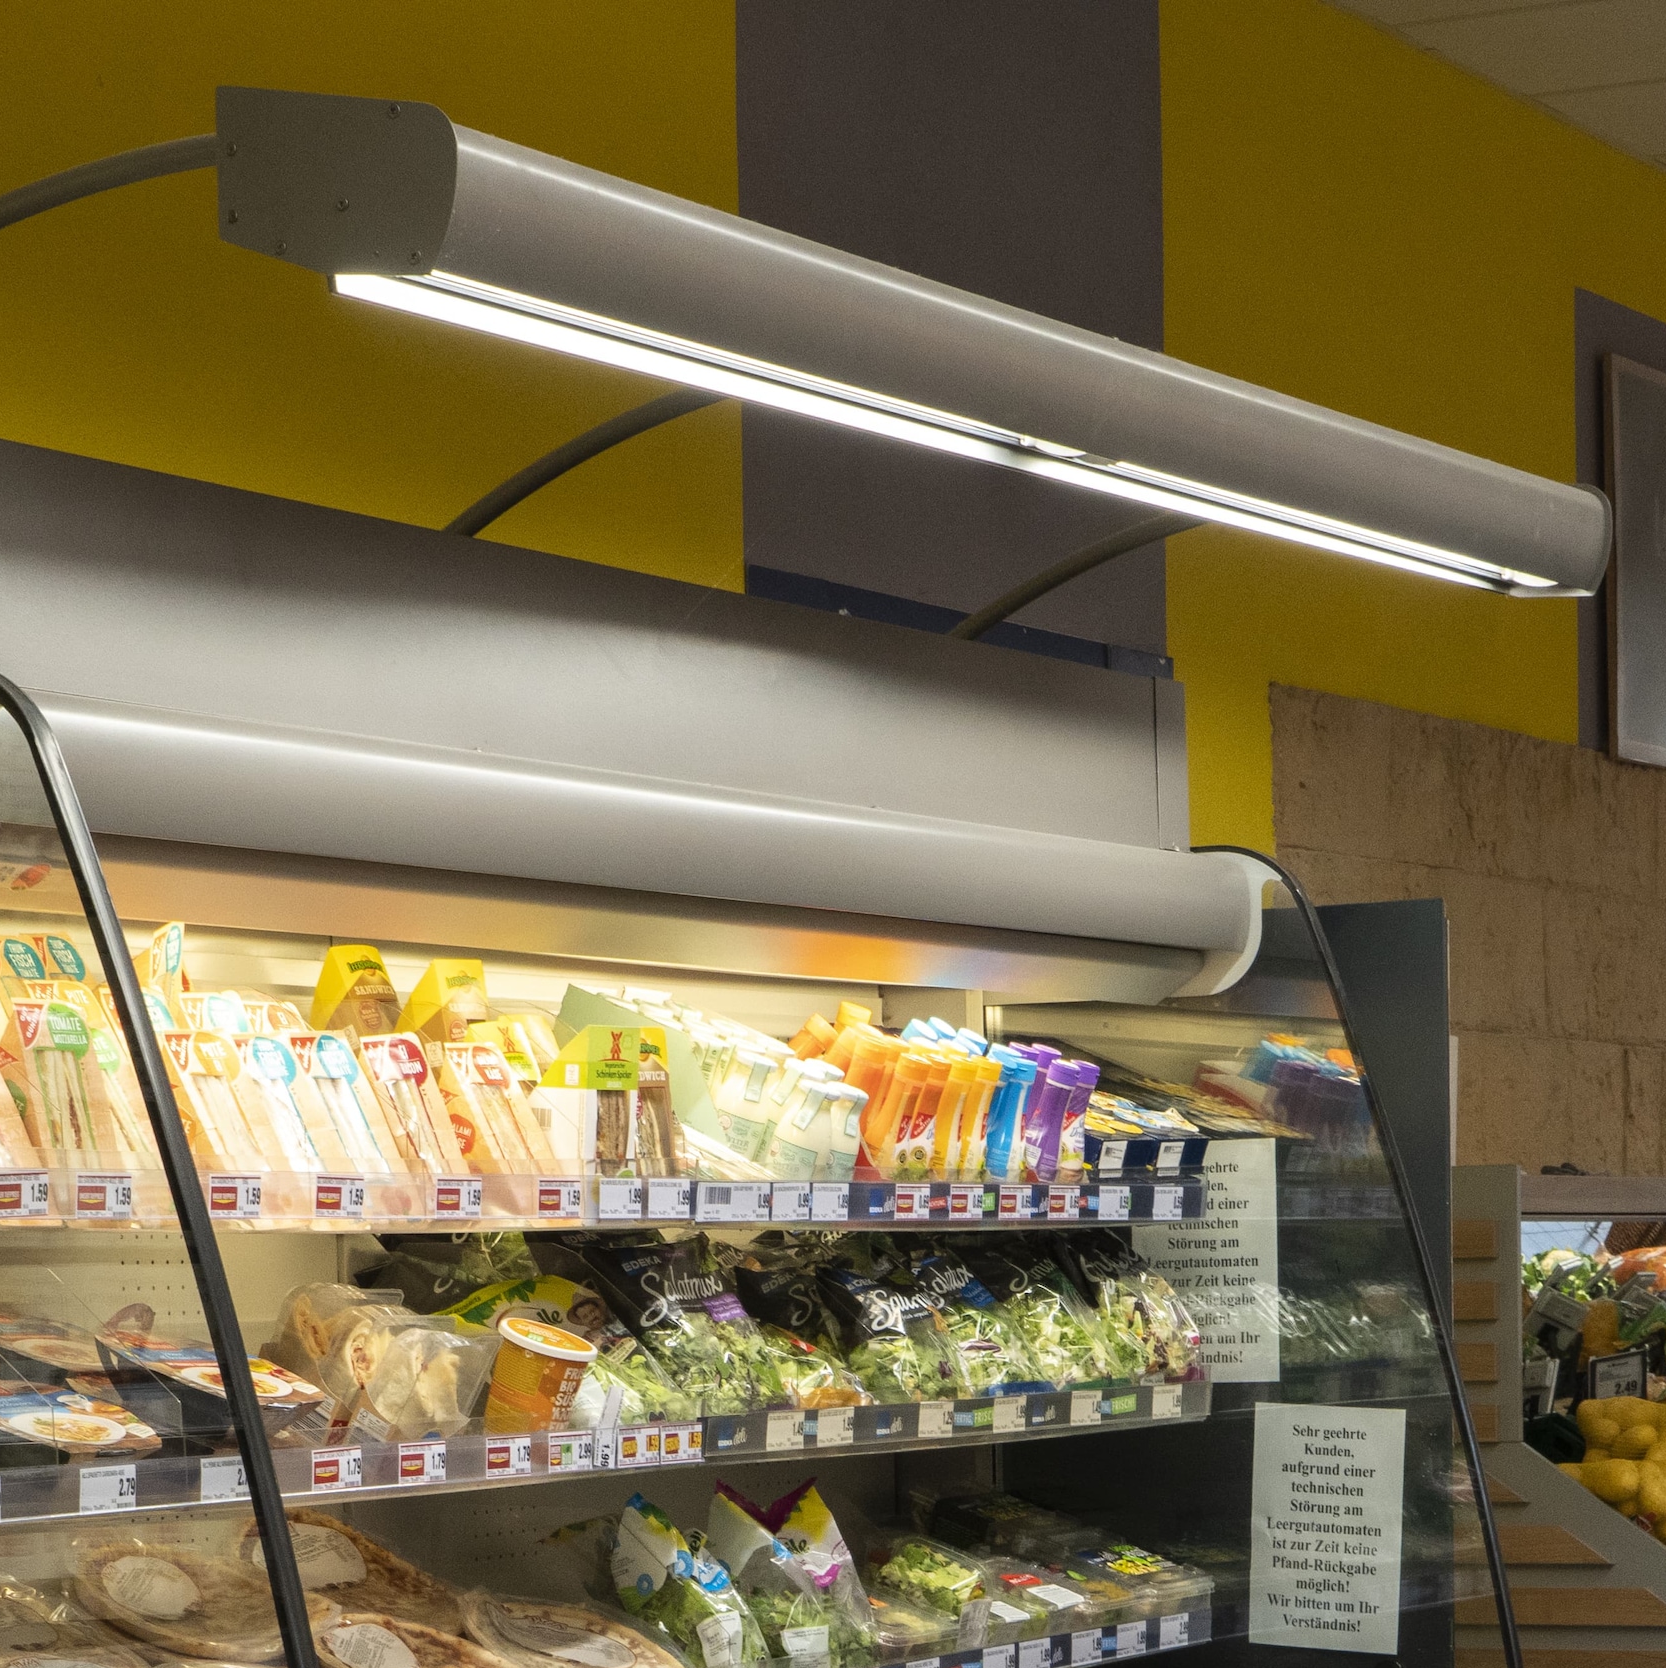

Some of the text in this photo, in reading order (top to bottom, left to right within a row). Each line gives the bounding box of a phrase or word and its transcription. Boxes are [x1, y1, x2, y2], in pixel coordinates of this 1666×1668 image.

[49, 1015, 82, 1031] TOMATE
[30, 1183, 48, 1203] 1.59
[1218, 1200, 1249, 1210] einer
[1168, 1238, 1239, 1251] Störung am
[621, 1256, 662, 1273] EDEKA
[1172, 1275, 1256, 1288] zur Zeit keine
[1614, 1380, 1638, 1396] 2.49
[1293, 1425, 1367, 1441] Sehr geehrte
[1304, 1443, 1355, 1458] Kunden,
[1282, 1462, 1376, 1478] aufgrund einer
[1291, 1481, 1364, 1497] technischen
[1290, 1499, 1363, 1517] Störung am
[1267, 1516, 1382, 1537] Leergutautomaten
[1272, 1537, 1378, 1556] ist zur Zeit keine
[1272, 1556, 1377, 1577] Pfand-Rückgabe
[1296, 1578, 1350, 1594] möglich!
[1267, 1593, 1379, 1615] Wir bitten um Ihr
[1283, 1614, 1361, 1633] Verständnis!
